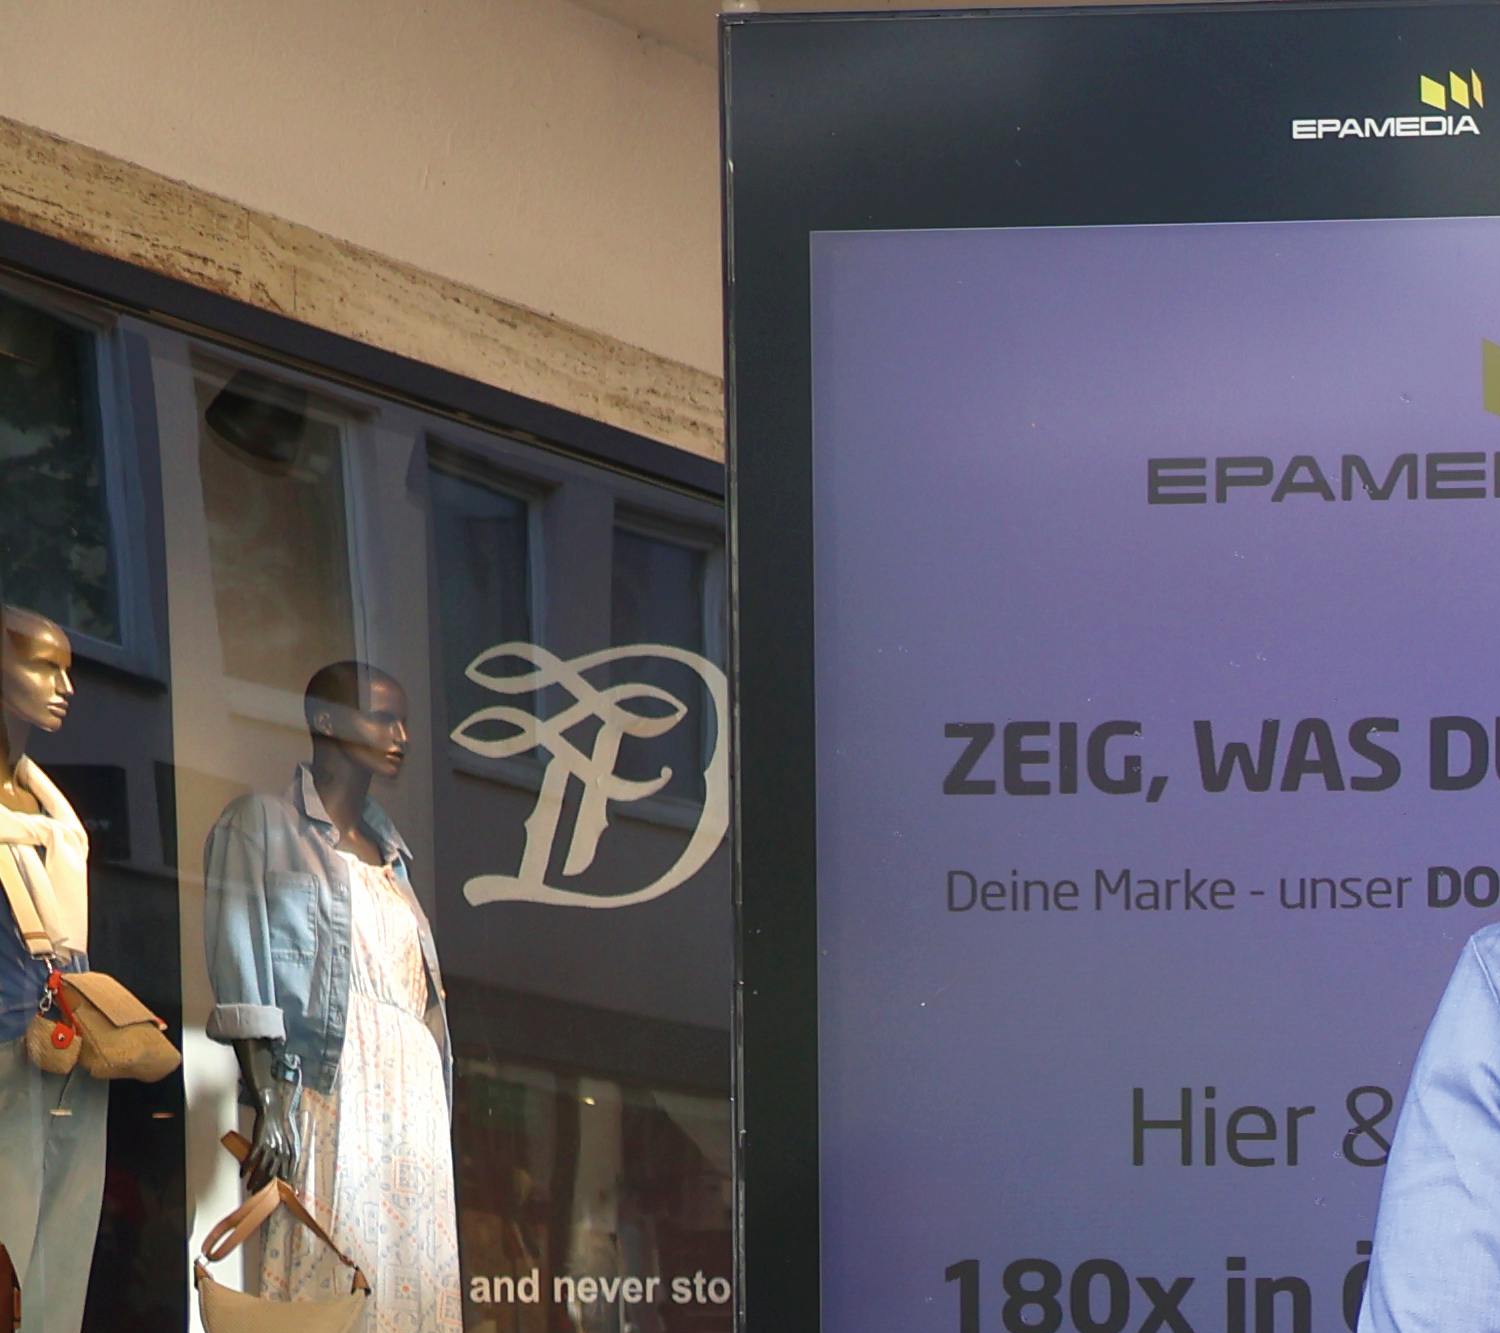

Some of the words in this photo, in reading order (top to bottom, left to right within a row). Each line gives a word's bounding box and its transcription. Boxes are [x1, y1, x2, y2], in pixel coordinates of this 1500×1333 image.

[1293, 116, 1480, 139] EPAMEDIA
[943, 720, 1168, 802] ZEIG,
[1194, 717, 1401, 792] WAS
[947, 869, 1079, 912] Deine
[1095, 869, 1235, 911] Marke
[1280, 877, 1412, 909] unser
[1133, 1086, 1315, 1167] Hier
[469, 1268, 540, 1304] and
[554, 1276, 660, 1303] never
[671, 1271, 731, 1304] sto
